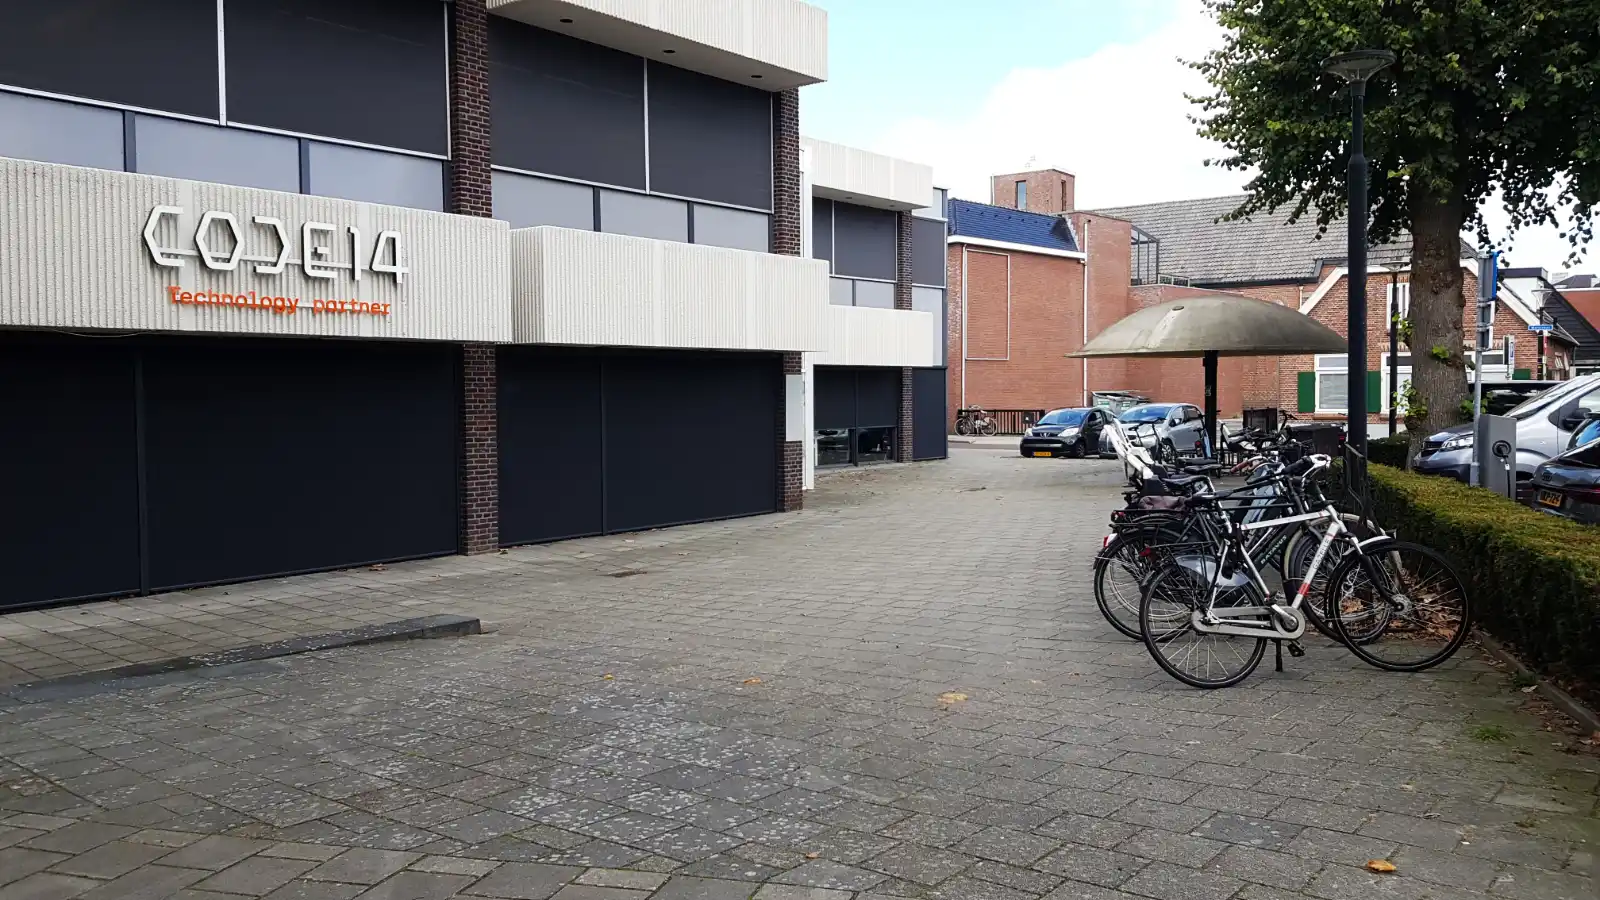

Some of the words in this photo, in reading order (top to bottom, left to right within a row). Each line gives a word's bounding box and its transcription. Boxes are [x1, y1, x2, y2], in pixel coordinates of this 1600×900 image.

[142, 205, 409, 283] CODE14
[167, 285, 299, 314] Technology
[312, 298, 391, 316] partner
[1313, 537, 1330, 569] GAZELLE
